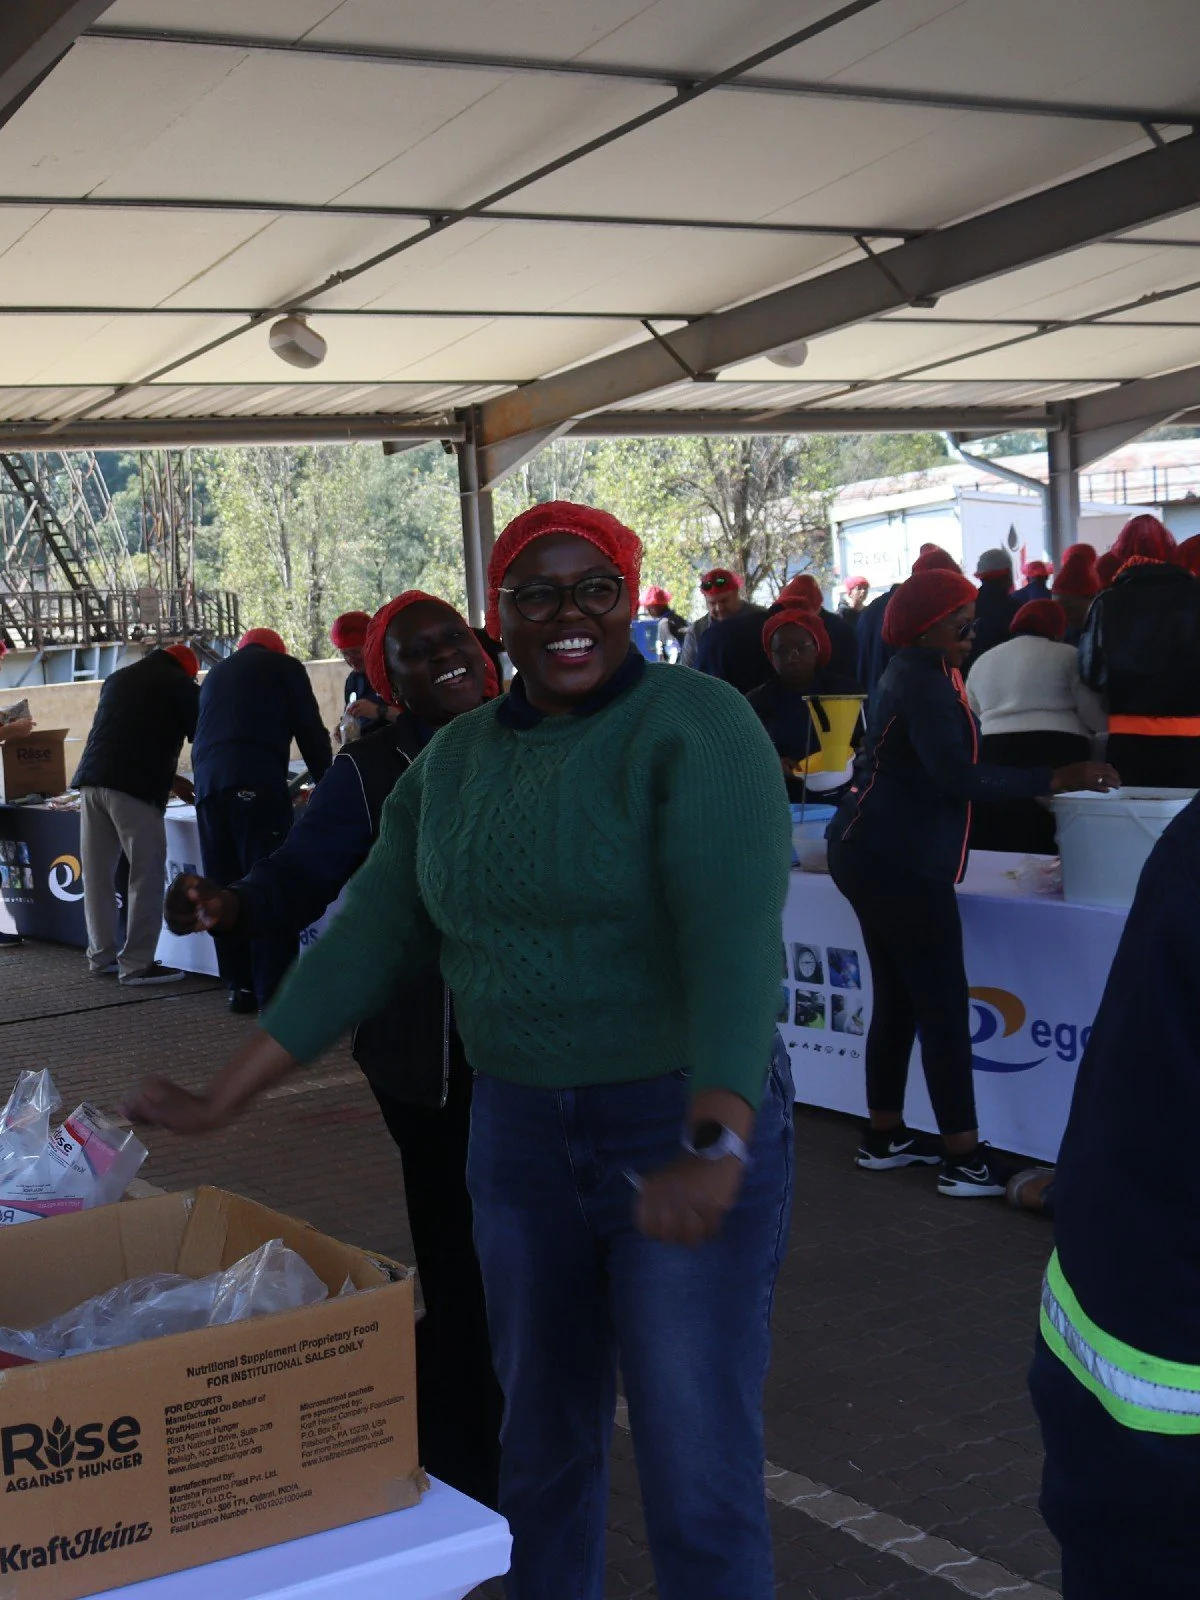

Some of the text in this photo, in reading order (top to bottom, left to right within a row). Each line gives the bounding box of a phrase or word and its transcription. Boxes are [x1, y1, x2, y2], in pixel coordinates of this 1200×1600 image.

[17, 747, 52, 761] Rise
[187, 1321, 379, 1378] Nutritional Supplement (Proprietary Food)
[207, 1340, 364, 1388] FOR INSTITUTIONAL SALES ONLY
[164, 1395, 222, 1416] FOR EXPORTS
[165, 1394, 266, 1426] Manufactured On Behalf of
[300, 1386, 374, 1410] Micronutrient sachets
[313, 1402, 350, 1418] sponsored
[352, 1398, 362, 1408] by:
[166, 1416, 221, 1436] KraftHeinz for:
[301, 1420, 316, 1430] Kraft
[318, 1415, 336, 1425] Heinz
[338, 1406, 368, 1420] Company
[337, 1430, 348, 1439] PA
[372, 1419, 386, 1428] USA
[166, 1422, 239, 1444] Rise Against Hunger
[167, 1422, 273, 1456] 3733 National Drive, Suite 200
[317, 1426, 330, 1435] Box
[0, 1415, 141, 1476] Rise
[198, 1448, 211, 1458] NC
[238, 1437, 255, 1448] USA
[302, 1450, 314, 1459] For
[314, 1446, 331, 1455] more
[370, 1429, 384, 1438] visit
[6, 1452, 142, 1493] AGAINST HUNGER
[169, 1472, 234, 1494] Manufactured by:
[170, 1491, 200, 1504] Manisha
[231, 1477, 248, 1488] Plast
[220, 1507, 248, 1521] Number
[0, 1521, 153, 1574] KraftHeinz
